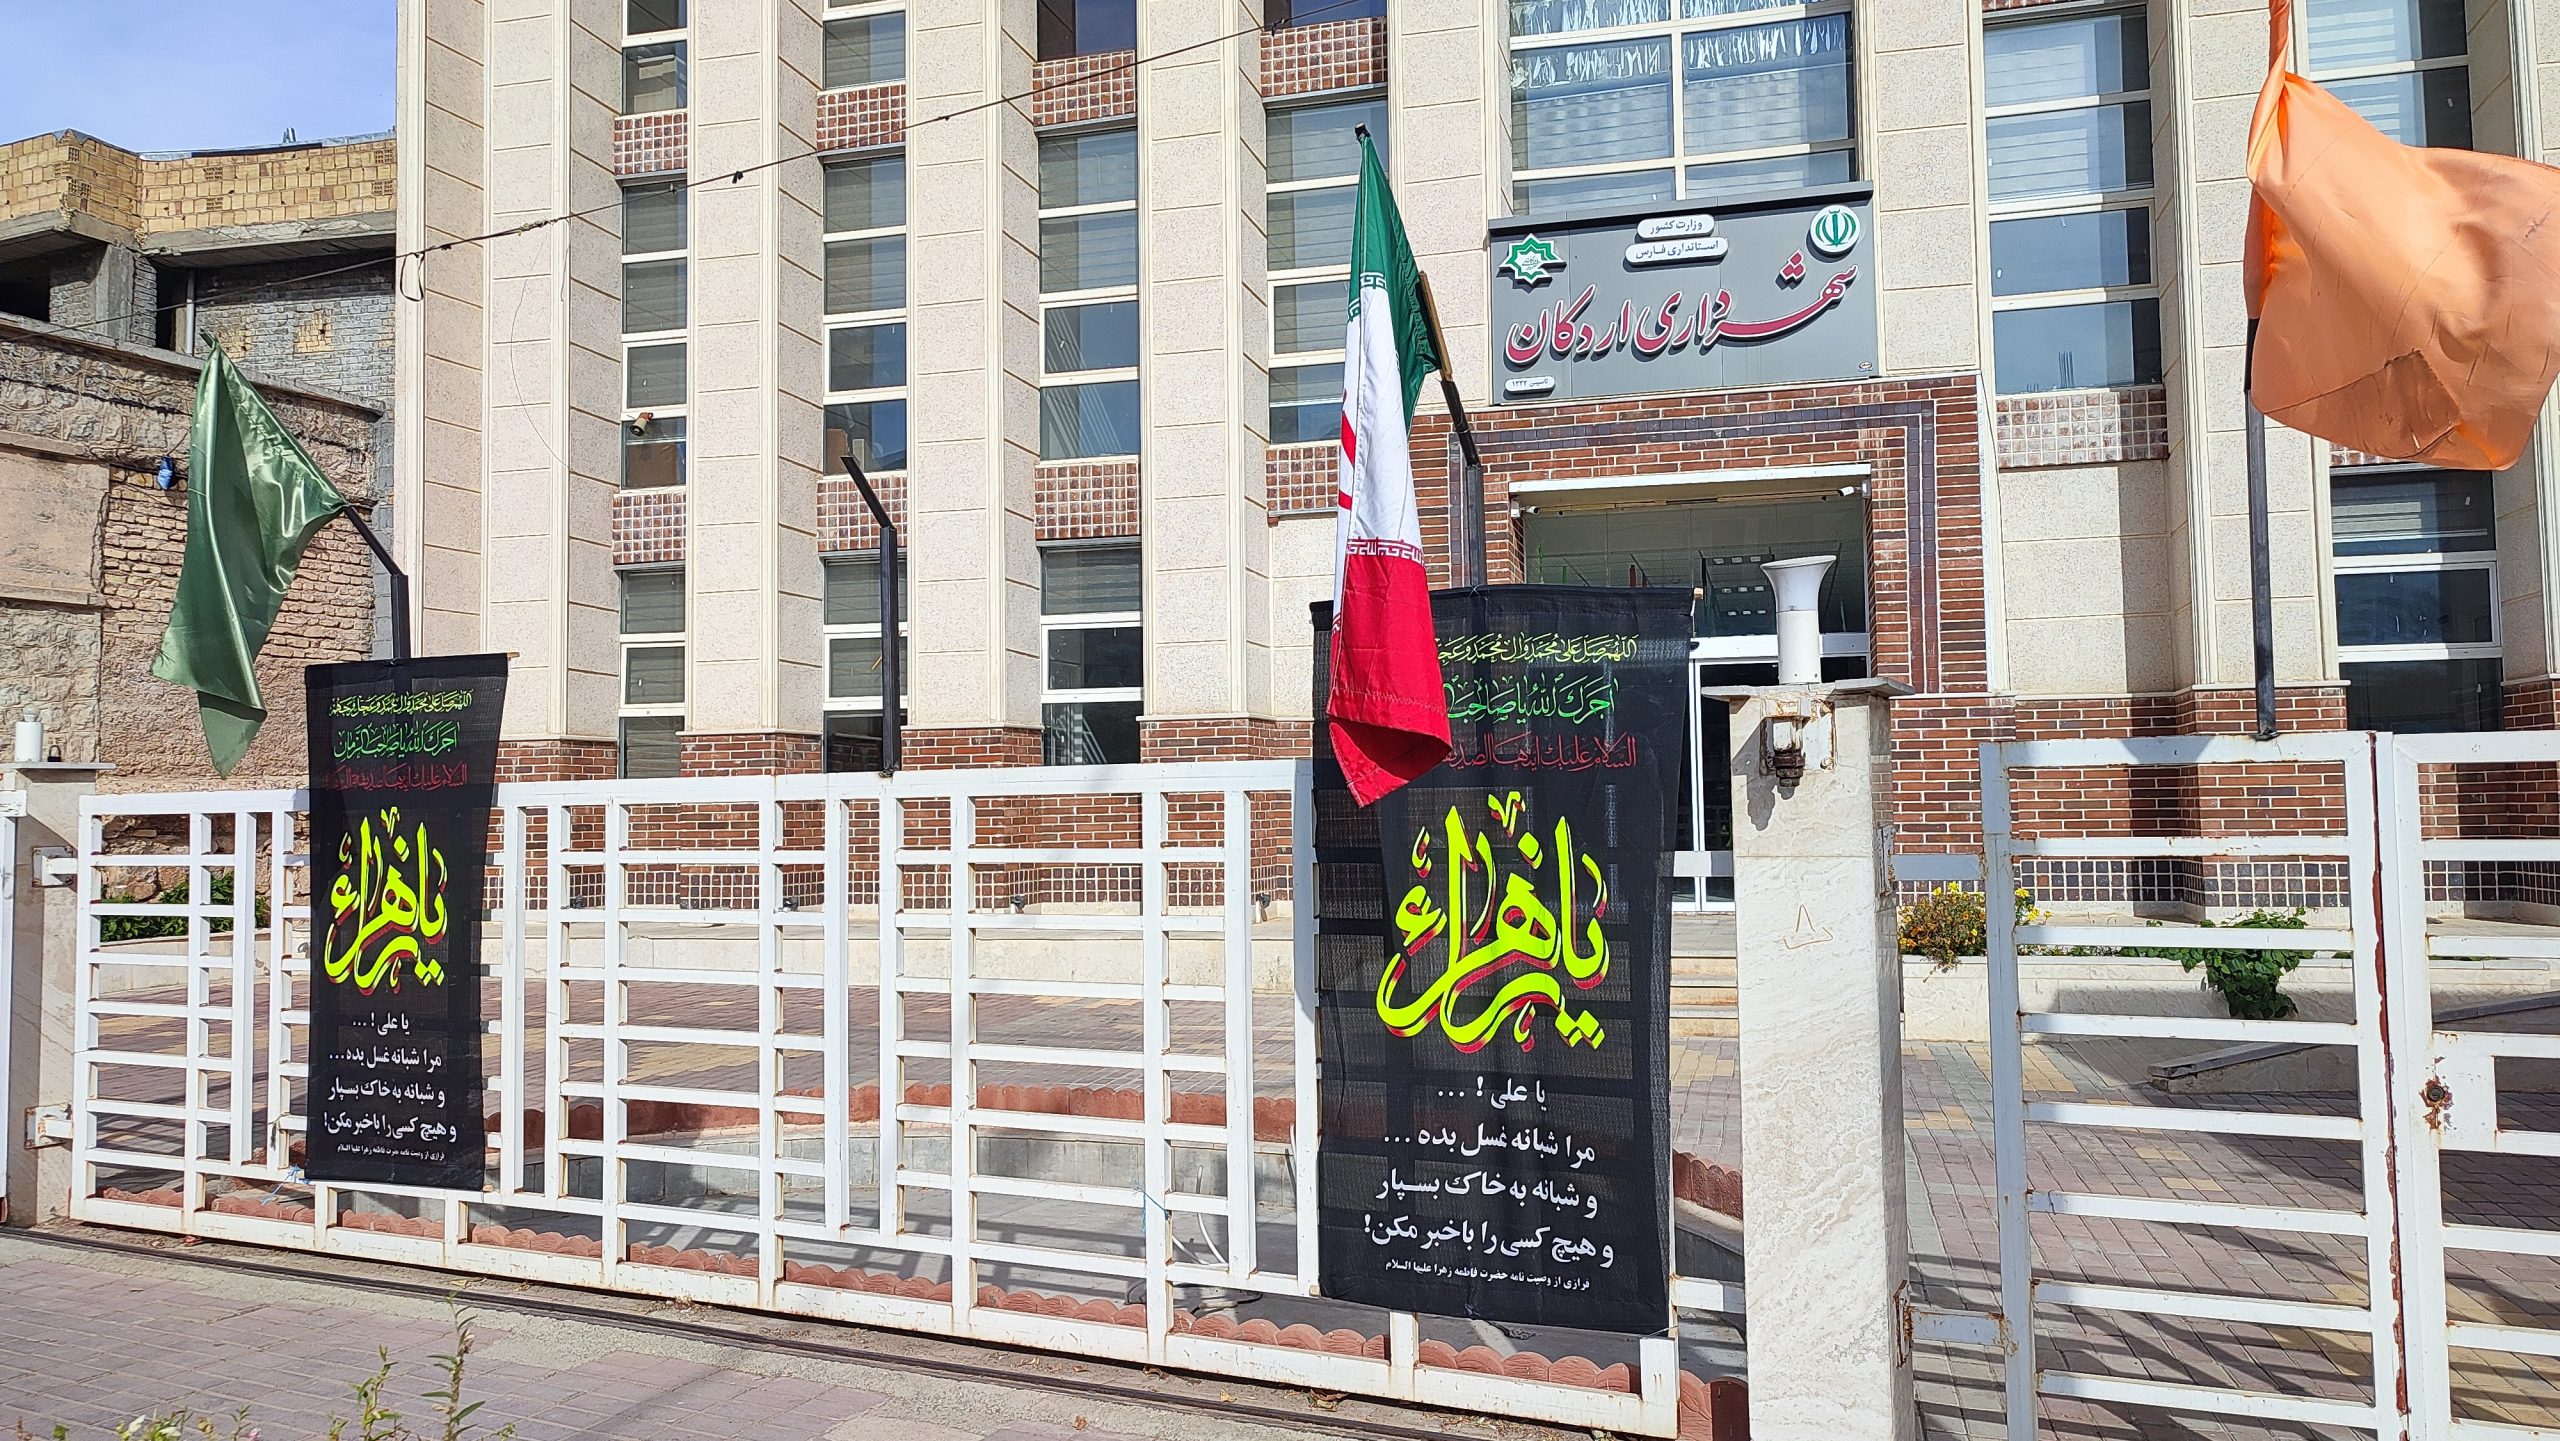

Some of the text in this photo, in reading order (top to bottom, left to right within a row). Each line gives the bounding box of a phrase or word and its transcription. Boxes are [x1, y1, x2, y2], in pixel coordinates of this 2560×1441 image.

[1650, 219, 1703, 234] وزارت کشور
[1635, 240, 1719, 259] استانداری فارس
[1505, 249, 1858, 364] شهرداری اردکان
[377, 1012, 398, 1036] علی
[401, 1012, 410, 1035] یا
[366, 1045, 390, 1069] غسل
[391, 1048, 420, 1070] شبانه
[423, 1049, 442, 1073] مرا
[328, 1077, 359, 1101] بسپار
[392, 1085, 402, 1104] به
[404, 1082, 435, 1105] شبانه
[437, 1090, 446, 1108] و
[1490, 1078, 1528, 1109] علی
[1535, 1080, 1546, 1111] یا
[381, 1114, 392, 1137] را
[392, 1116, 419, 1139] کسی
[420, 1121, 447, 1141] هیچ
[449, 1125, 457, 1143] و
[1460, 1123, 1507, 1157] غسل
[1511, 1128, 1559, 1158] شبانه
[1565, 1135, 1595, 1169] مرا
[1376, 1168, 1440, 1200] بسپار
[1509, 1180, 1527, 1207] به
[1532, 1182, 1580, 1211] شبانه
[1584, 1195, 1598, 1219] و
[1481, 1221, 1498, 1254] را
[1500, 1226, 1550, 1257] کسی
[1551, 1236, 1597, 1263] هیچ
[1600, 1244, 1614, 1268] و
[1385, 1259, 1411, 1271] السلام
[1433, 1263, 1453, 1278] زهرا
[1454, 1266, 1478, 1278] فاطمه
[1480, 1268, 1508, 1281] حضرت
[1510, 1271, 1525, 1282] نامه
[1526, 1273, 1552, 1286] وصیت
[1553, 1276, 1561, 1288] از
[1562, 1277, 1590, 1291] فرازی
